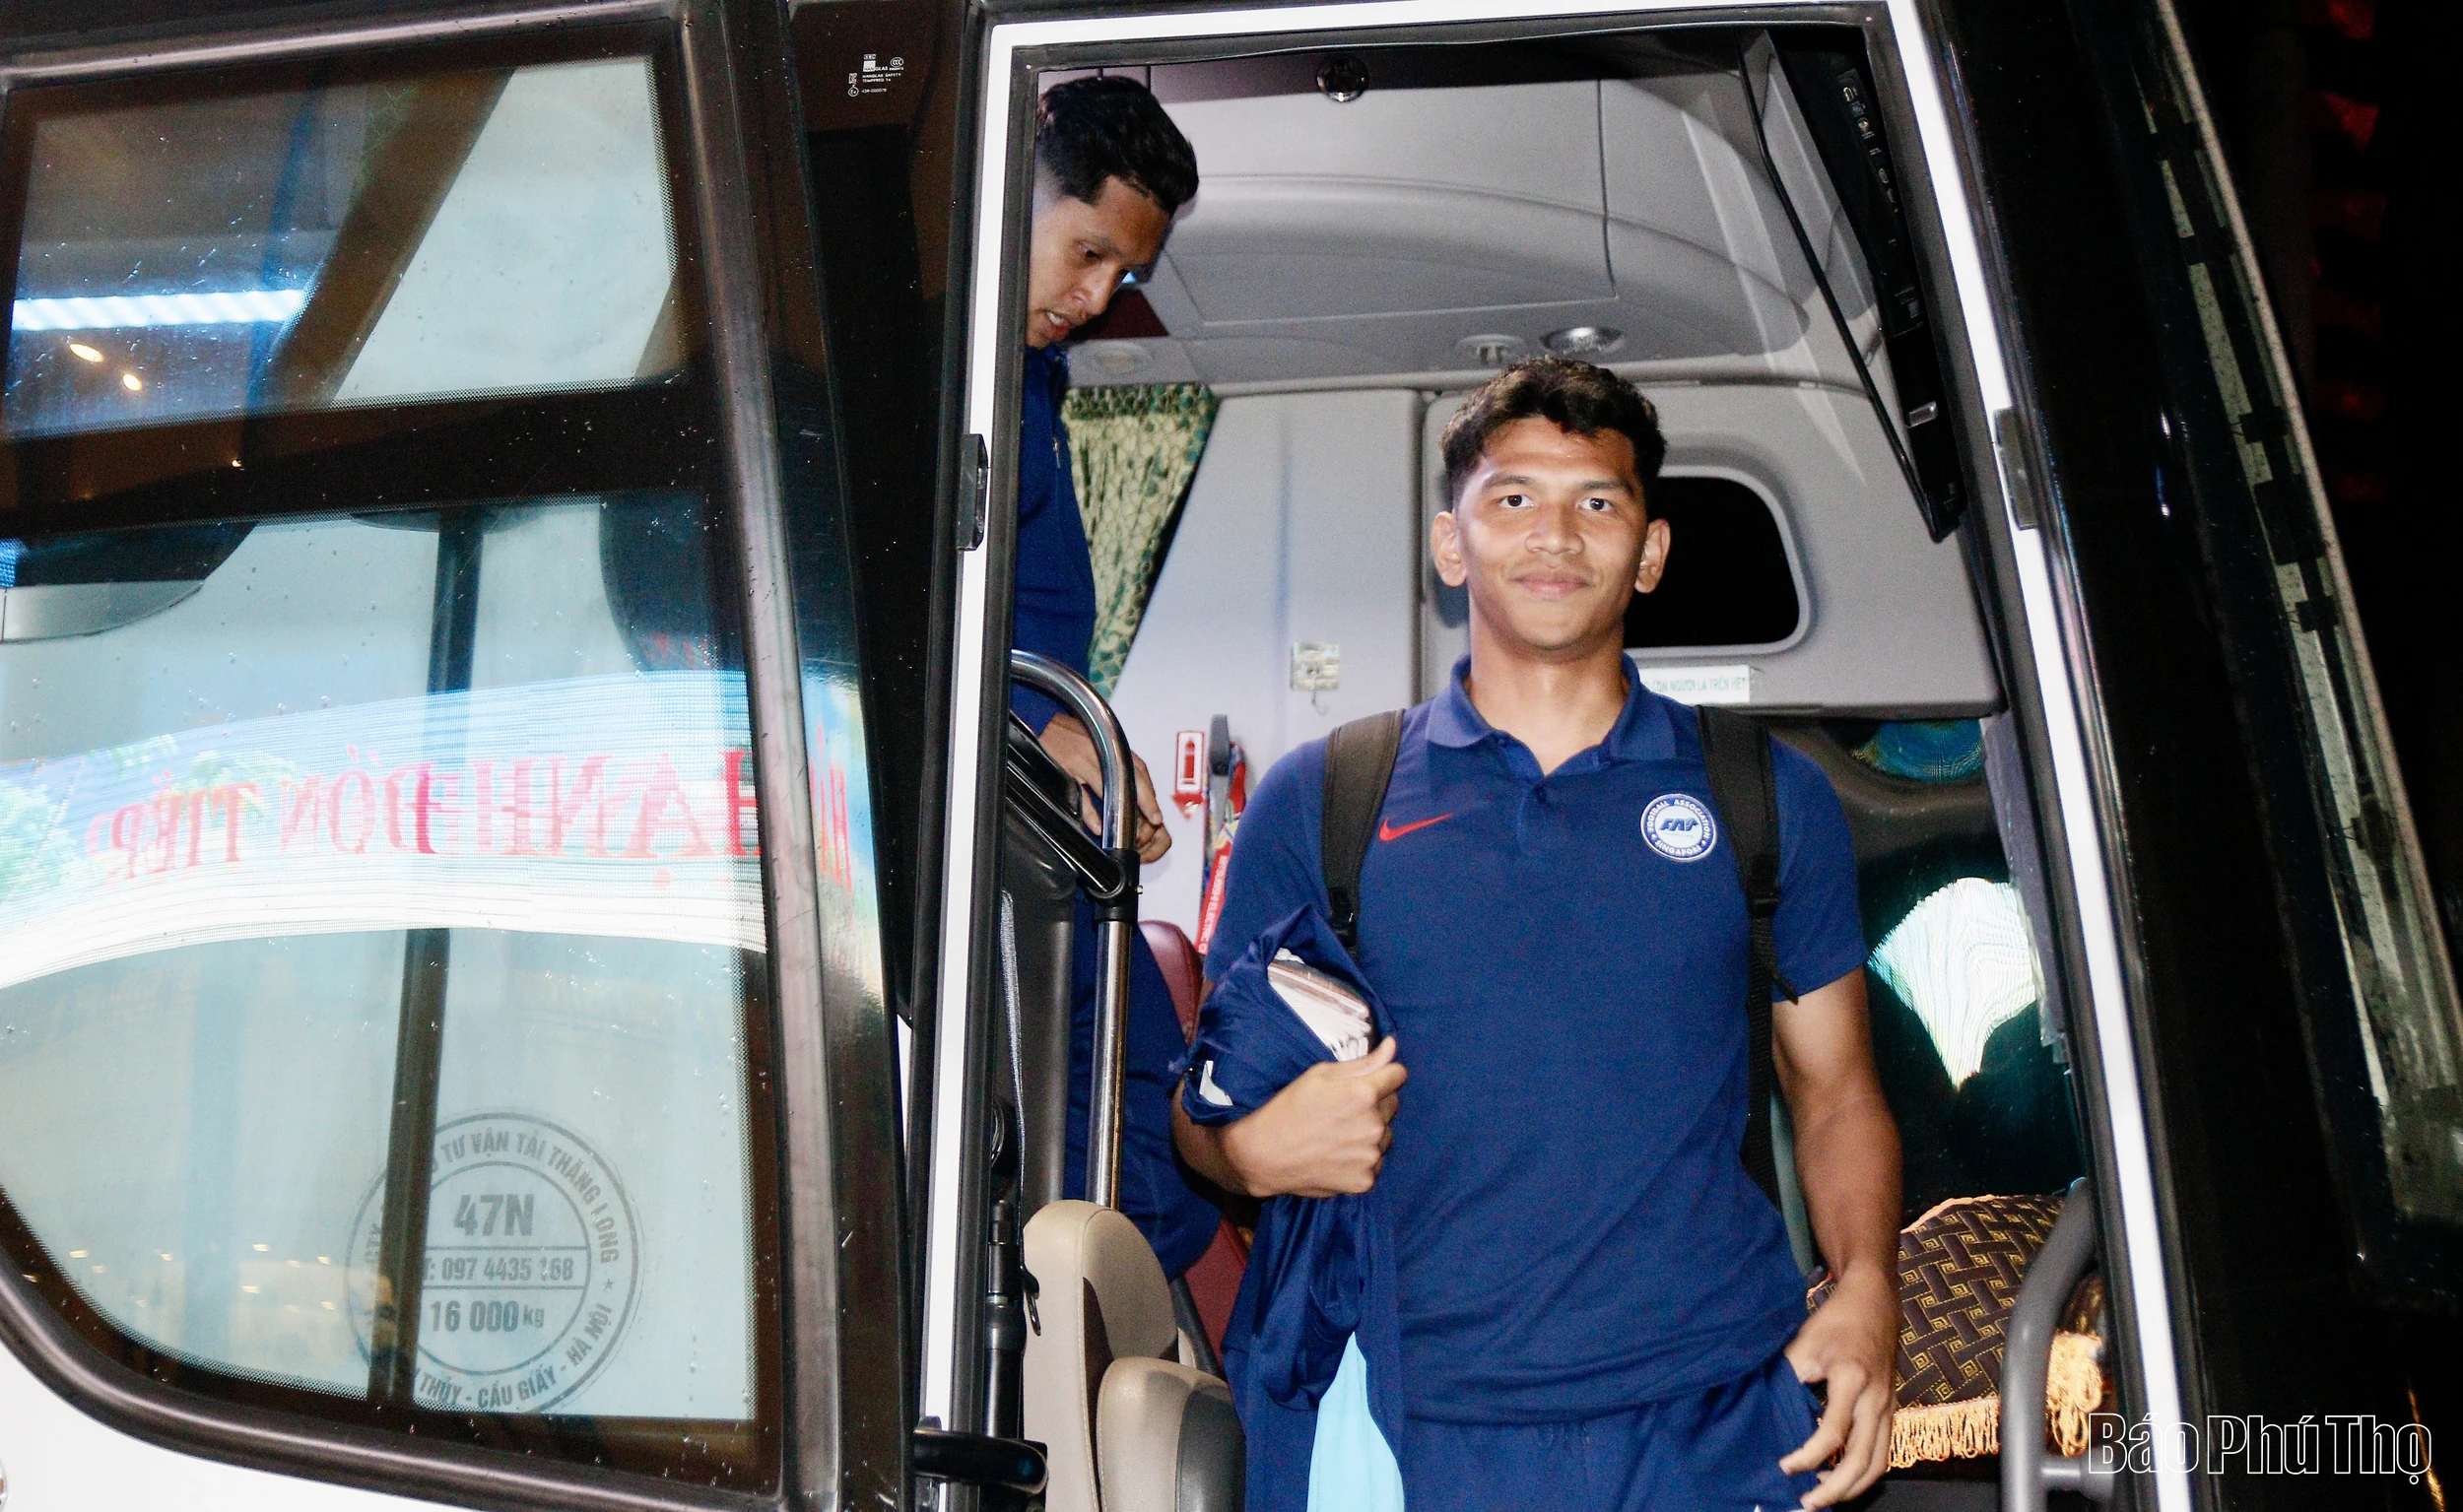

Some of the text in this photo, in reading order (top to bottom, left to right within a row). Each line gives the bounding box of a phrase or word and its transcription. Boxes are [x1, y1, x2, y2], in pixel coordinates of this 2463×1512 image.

[1646, 799, 1711, 839] FOOTBALL ASSOCIATION
[1659, 817, 1698, 831] FAS
[1654, 839, 1702, 856] SINGAPORE
[439, 1134, 466, 1163] TƯ
[471, 1128, 509, 1157] VẬN
[517, 1130, 547, 1160] TẢI
[547, 1146, 602, 1205] THĂNG
[590, 1202, 620, 1264] LONG
[453, 1193, 535, 1237] 47N
[442, 1257, 478, 1282] 097
[483, 1257, 533, 1282] 4435
[430, 1300, 546, 1333] 16 000 kg
[516, 1363, 558, 1402] GIẤY
[566, 1336, 593, 1367] HÀ
[583, 1302, 613, 1342] NỘI
